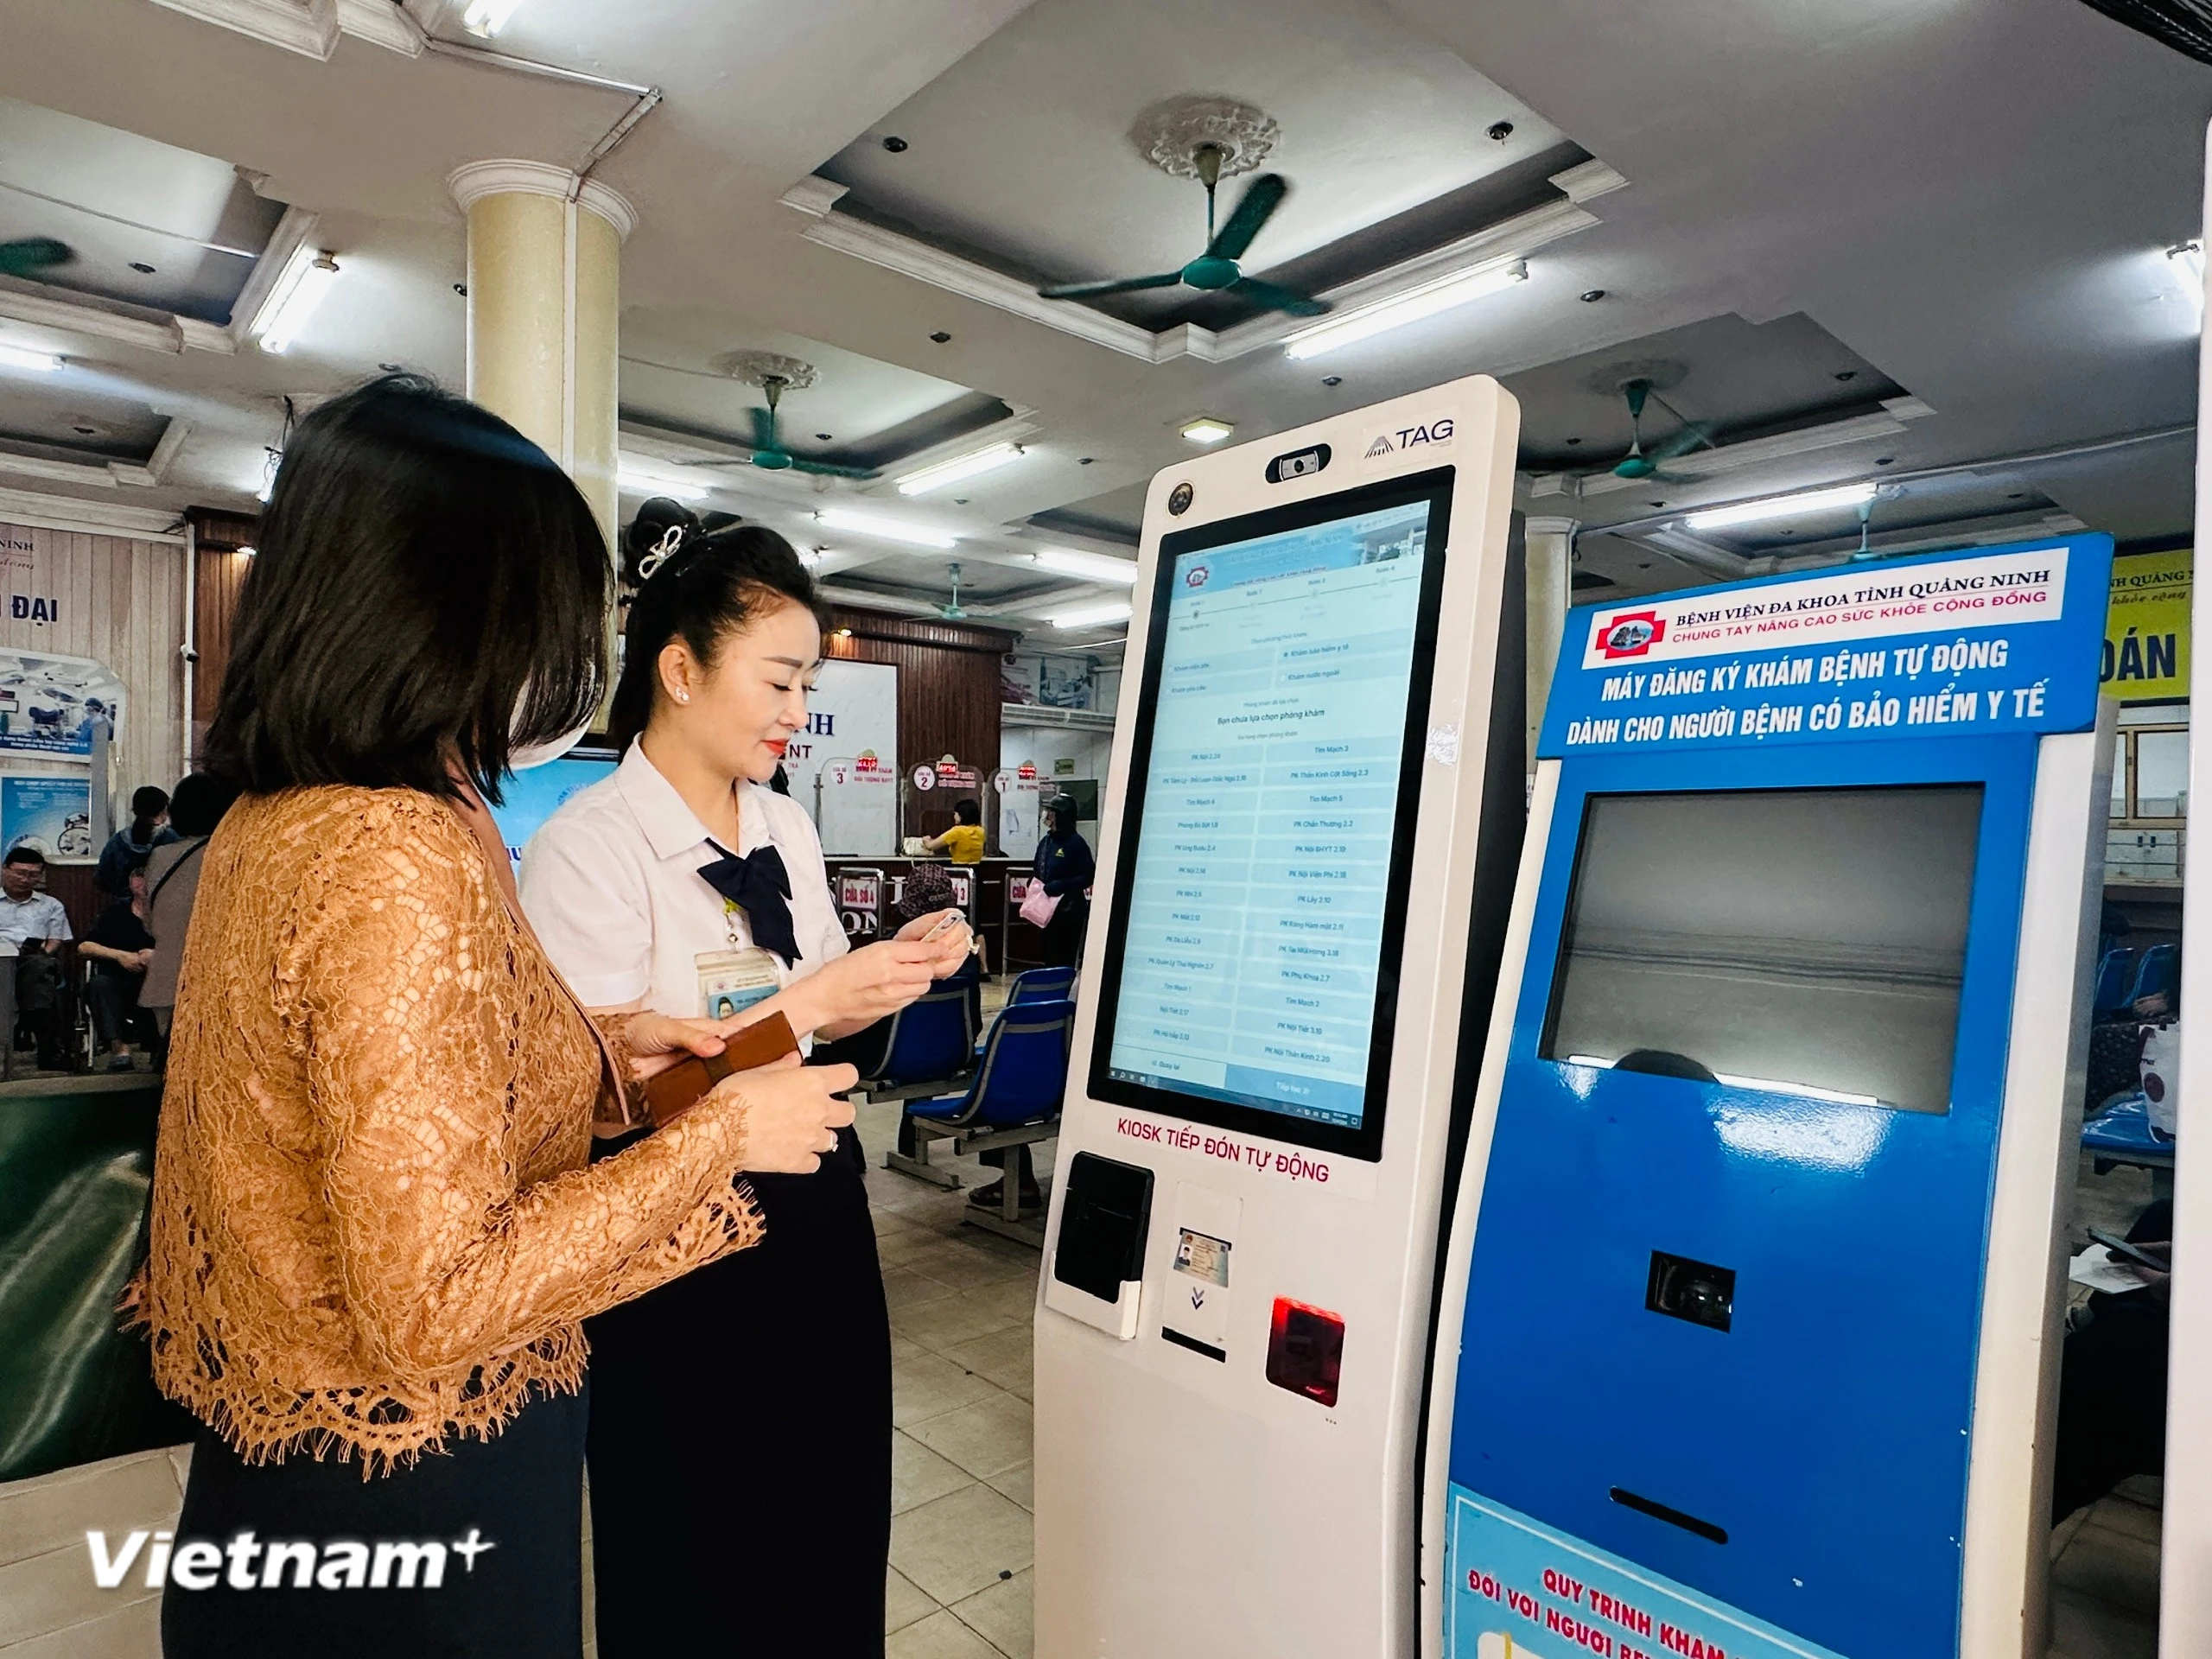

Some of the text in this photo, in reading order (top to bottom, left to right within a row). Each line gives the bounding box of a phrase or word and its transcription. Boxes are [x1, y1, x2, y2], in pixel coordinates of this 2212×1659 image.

[1395, 419, 1454, 449] TAG
[2130, 570, 2184, 588] QUẢNG
[12, 595, 57, 626] ĐẠI
[1676, 570, 2050, 626] BỆNH VIỆN ĐA KHOA TỈNH QUẢNG NINH
[1673, 590, 2047, 643] CHUNG TAY NÂNG CAO SỨC KHỎE CỘNG ĐỒNG
[1601, 638, 2009, 702] MÁY ĐĂNG KÝ KHÁM BỆNH TỰ ĐỘNG
[1217, 709, 1325, 726] Bạn chưa lựa chọn phòng khám
[1566, 677, 2050, 745] DÀNH CHO NGƯỜI BỆNH CÓ BẢO HIỂM Y TẾ
[836, 772, 843, 785] 3
[921, 777, 928, 788] 2
[1001, 782, 1006, 792] 1
[869, 889, 875, 905] 4
[959, 887, 965, 901] 3
[1117, 1117, 1330, 1183] KIOSK TIẾP ĐÓN TỰ ĐỘNG
[1542, 1568, 1583, 1604] QUY
